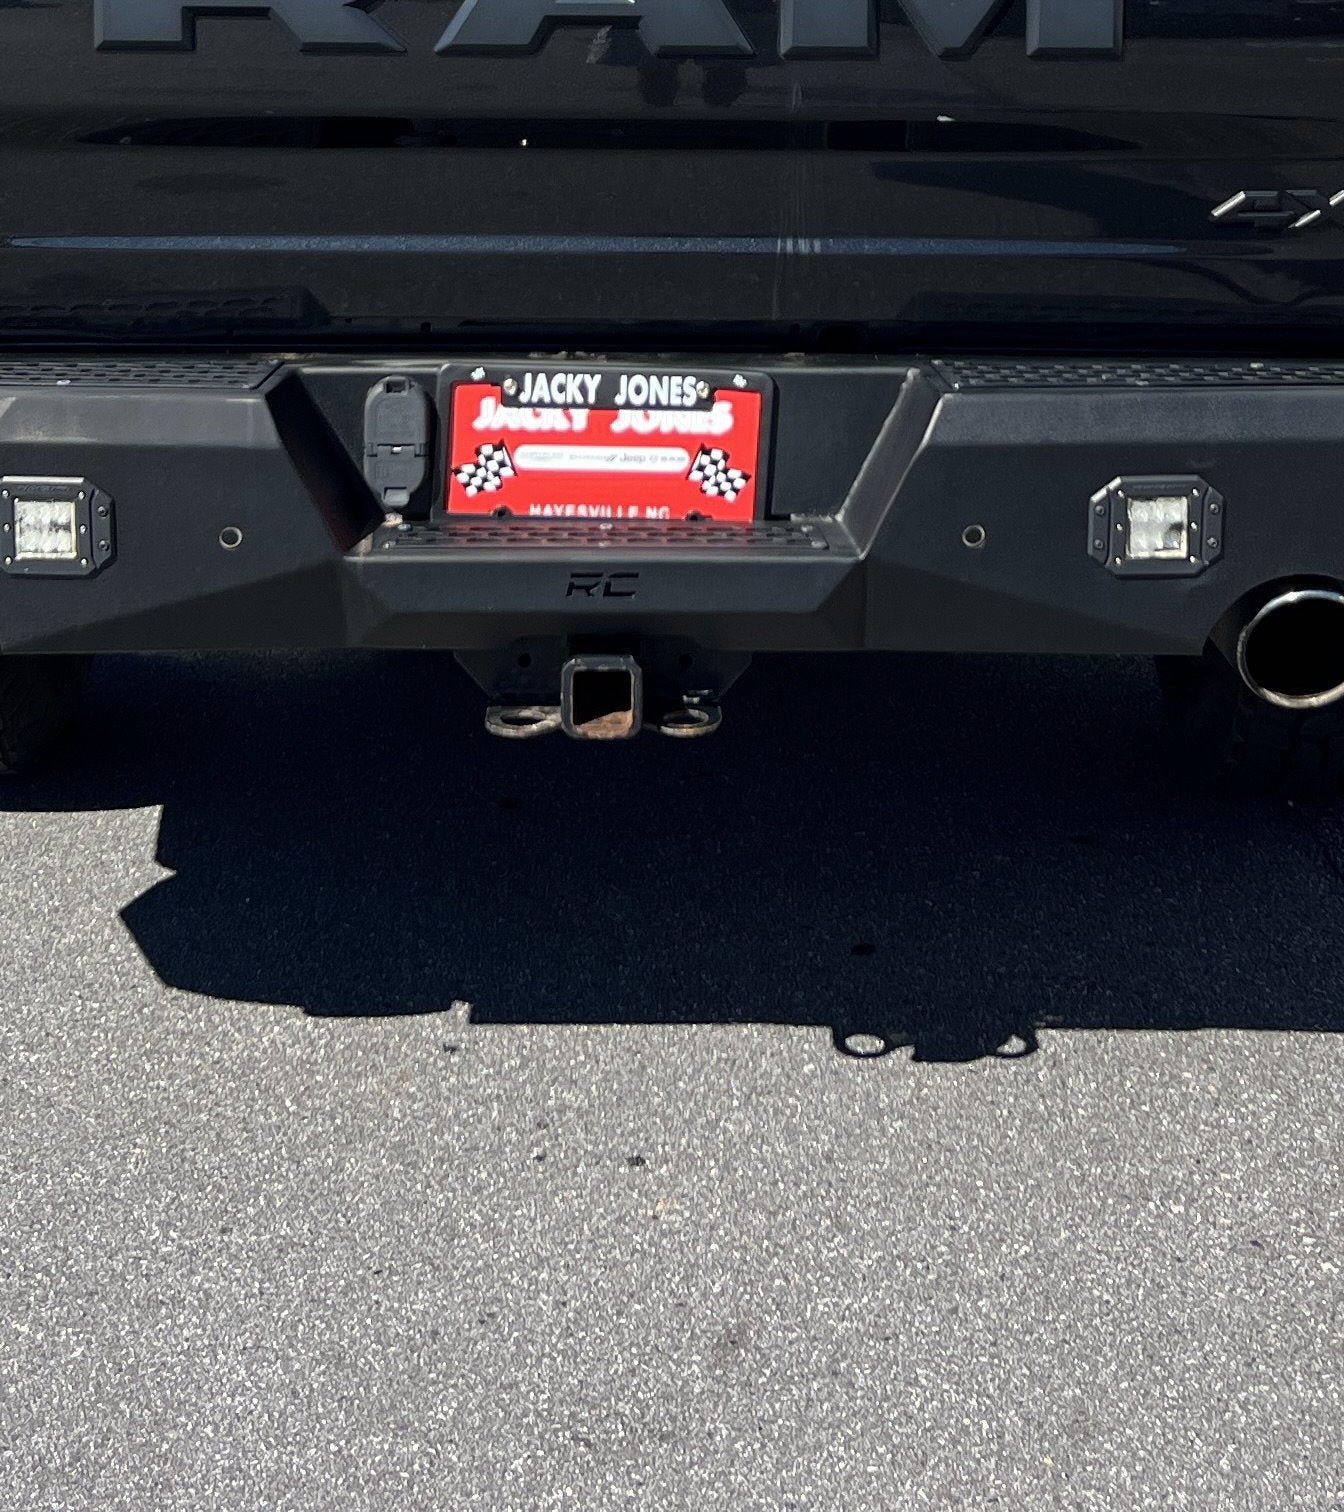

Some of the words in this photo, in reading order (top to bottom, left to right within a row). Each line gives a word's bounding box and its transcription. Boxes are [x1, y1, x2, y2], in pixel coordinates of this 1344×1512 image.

[518, 372, 601, 405] JACKY
[614, 374, 697, 406] JONES
[472, 398, 589, 432] JACKY
[610, 400, 735, 435] JONES
[566, 572, 640, 598] RC
